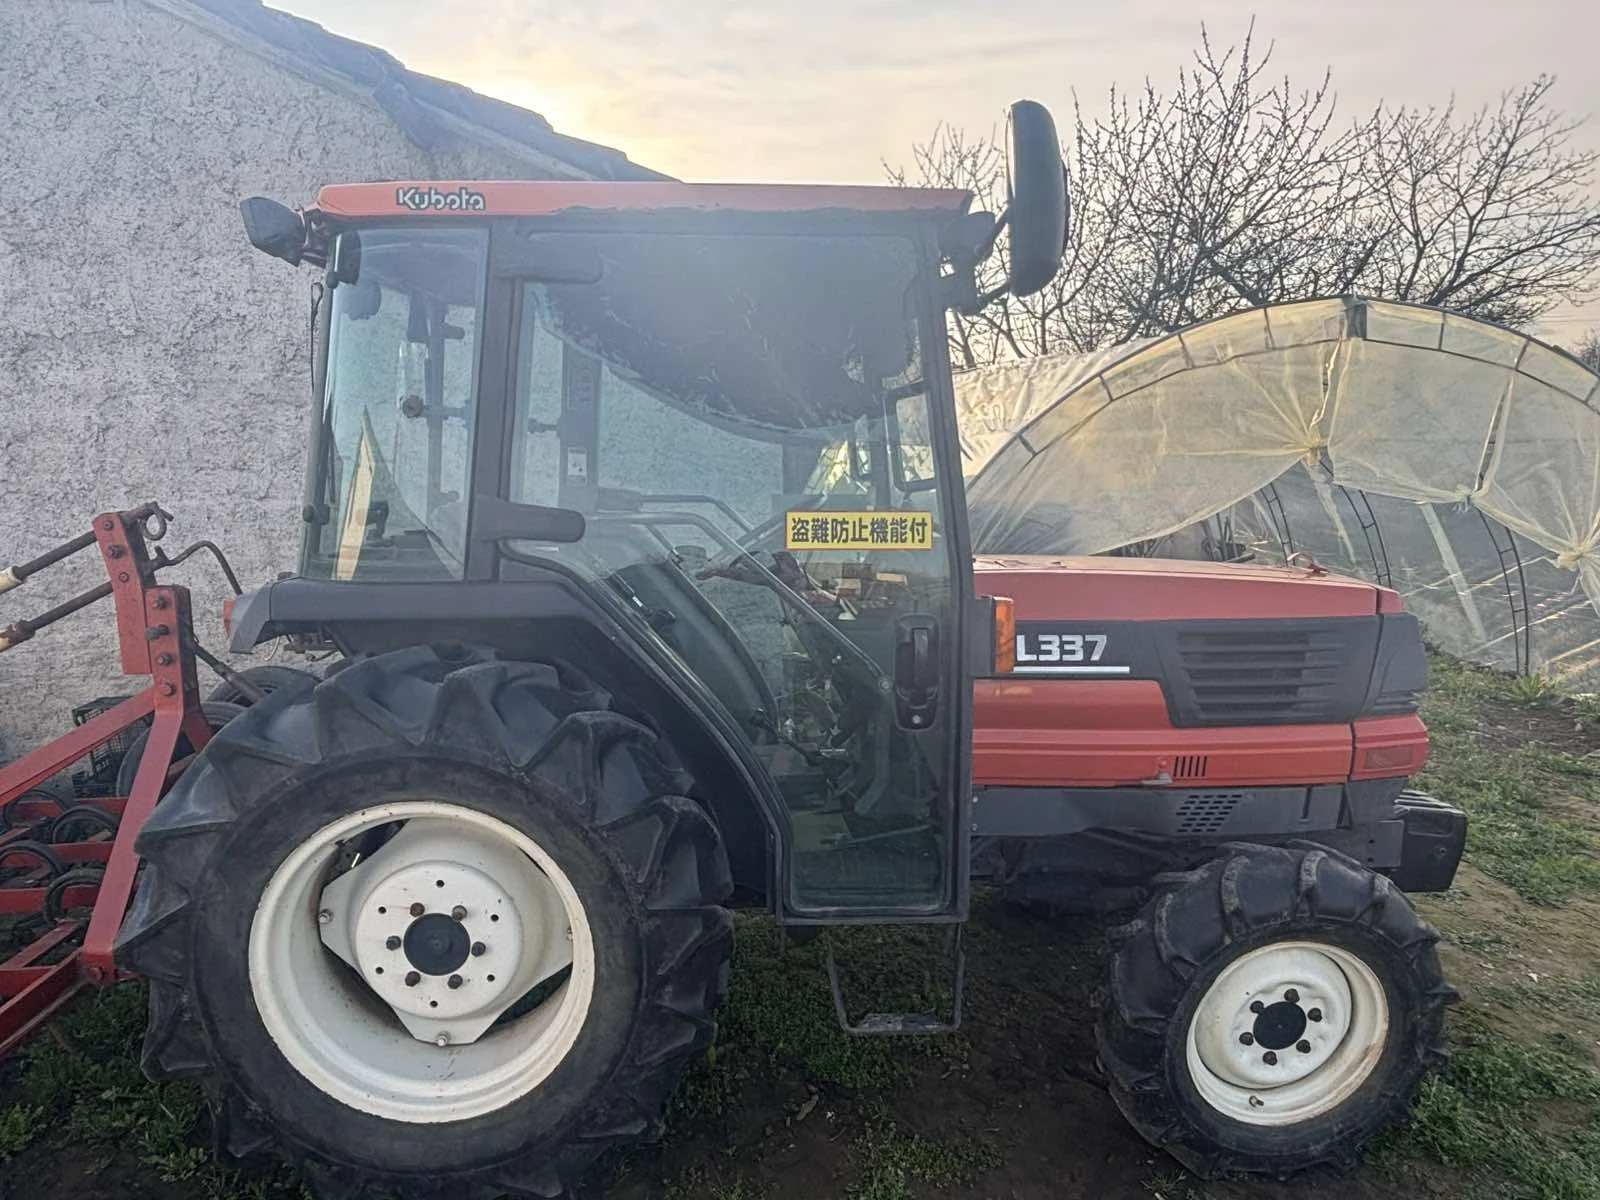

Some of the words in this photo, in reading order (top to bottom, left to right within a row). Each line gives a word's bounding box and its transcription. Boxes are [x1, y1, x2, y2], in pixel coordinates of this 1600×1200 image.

[397, 187, 485, 210] Kubota
[791, 517, 928, 544] 盗難防止機能付
[1016, 634, 1107, 661] L337
